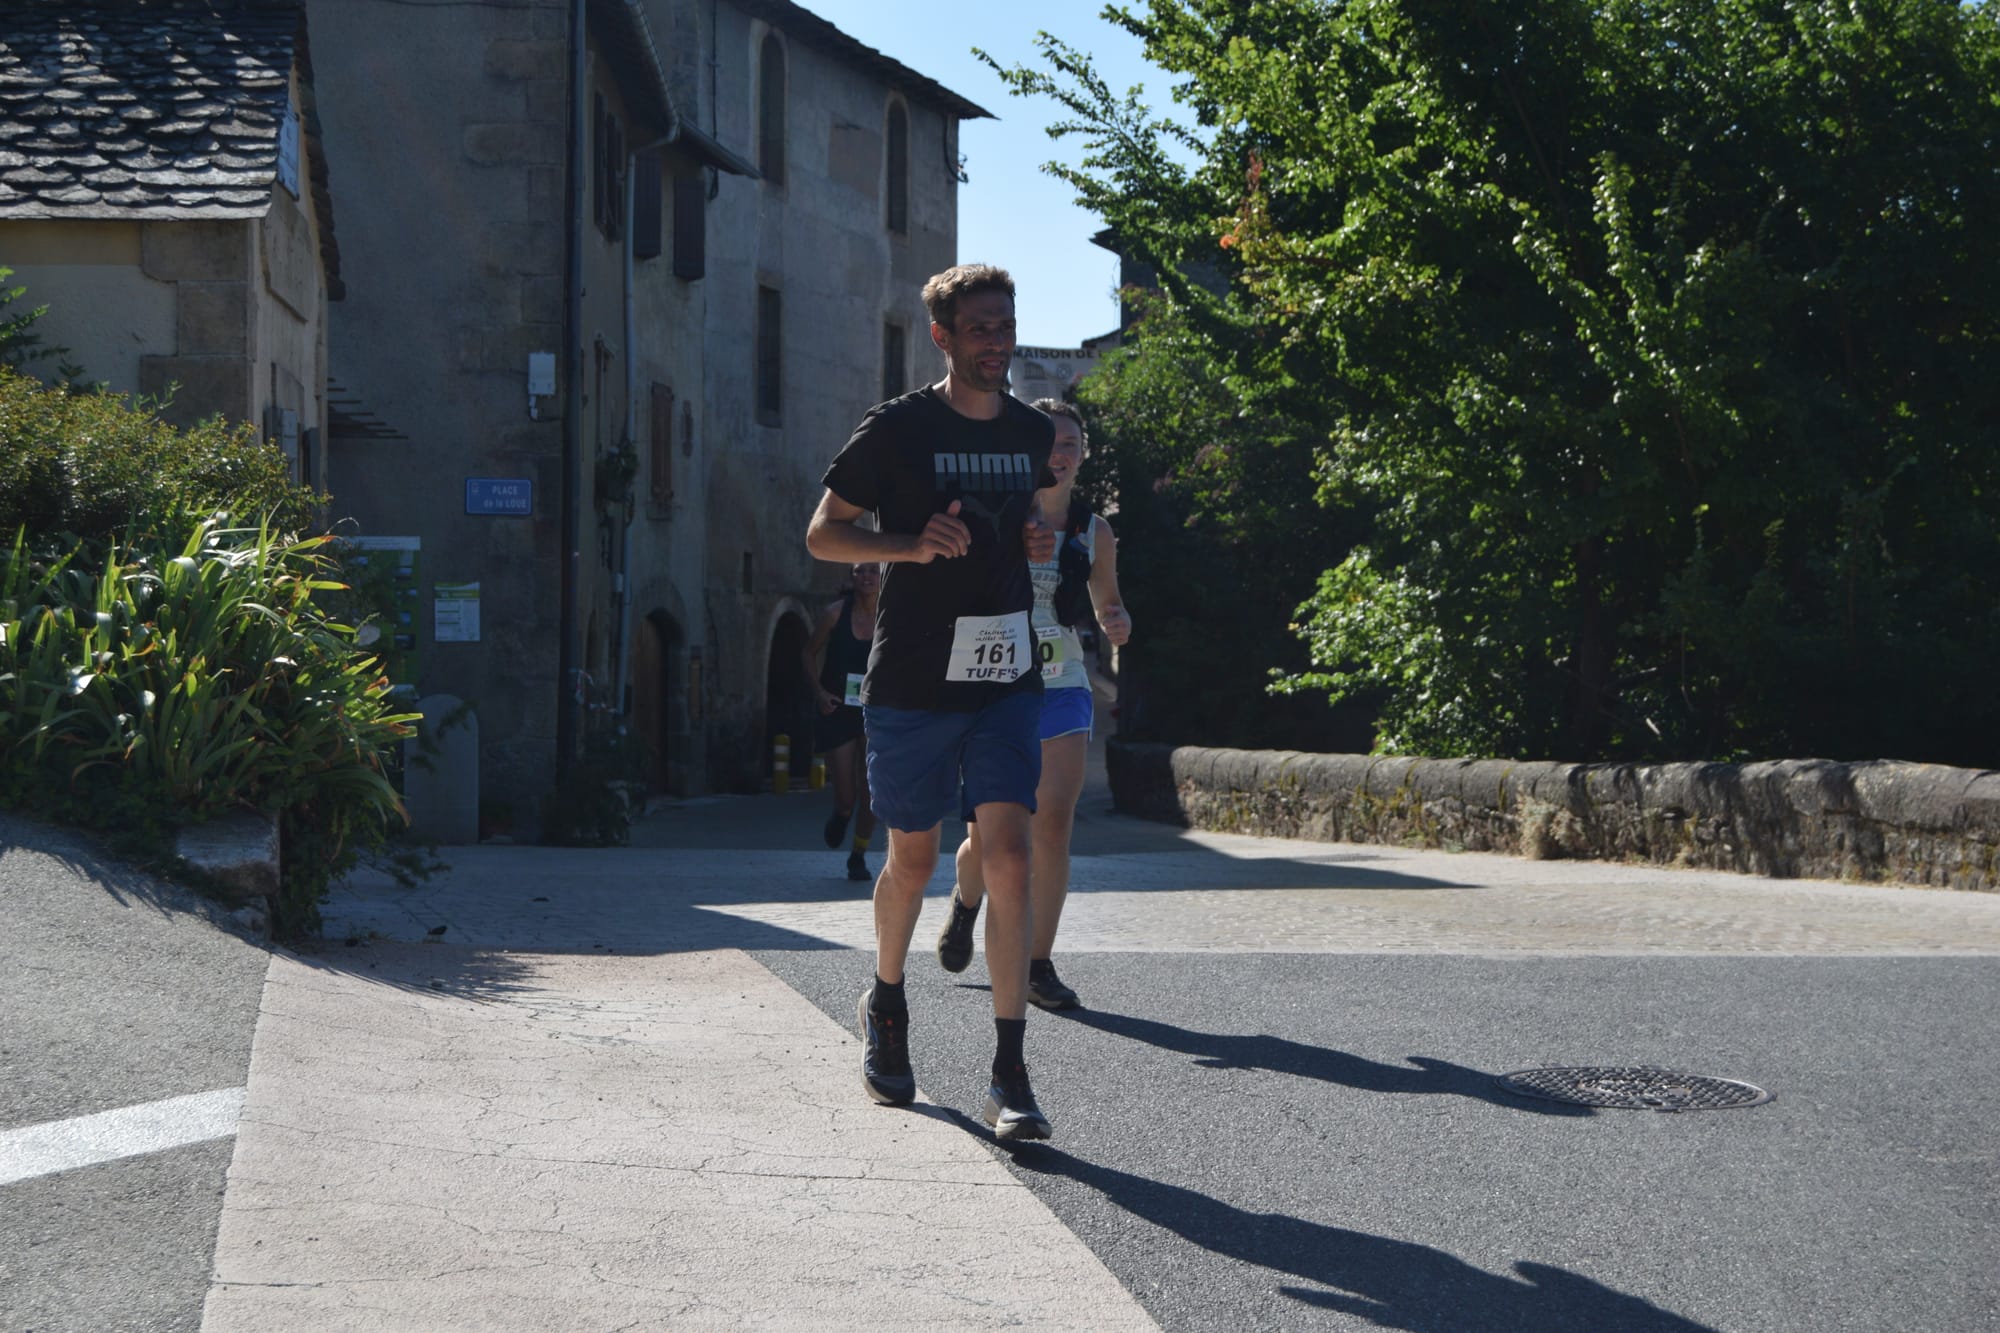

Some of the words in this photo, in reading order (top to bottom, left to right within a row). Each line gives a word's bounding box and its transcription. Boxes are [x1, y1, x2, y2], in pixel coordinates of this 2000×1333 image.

[1013, 348, 1071, 359] MAISON
[1076, 349, 1094, 359] DE
[934, 453, 1033, 492] PUMA
[492, 485, 518, 495] PLACE
[974, 642, 1016, 664] 161
[966, 667, 1019, 679] TUFF'S
